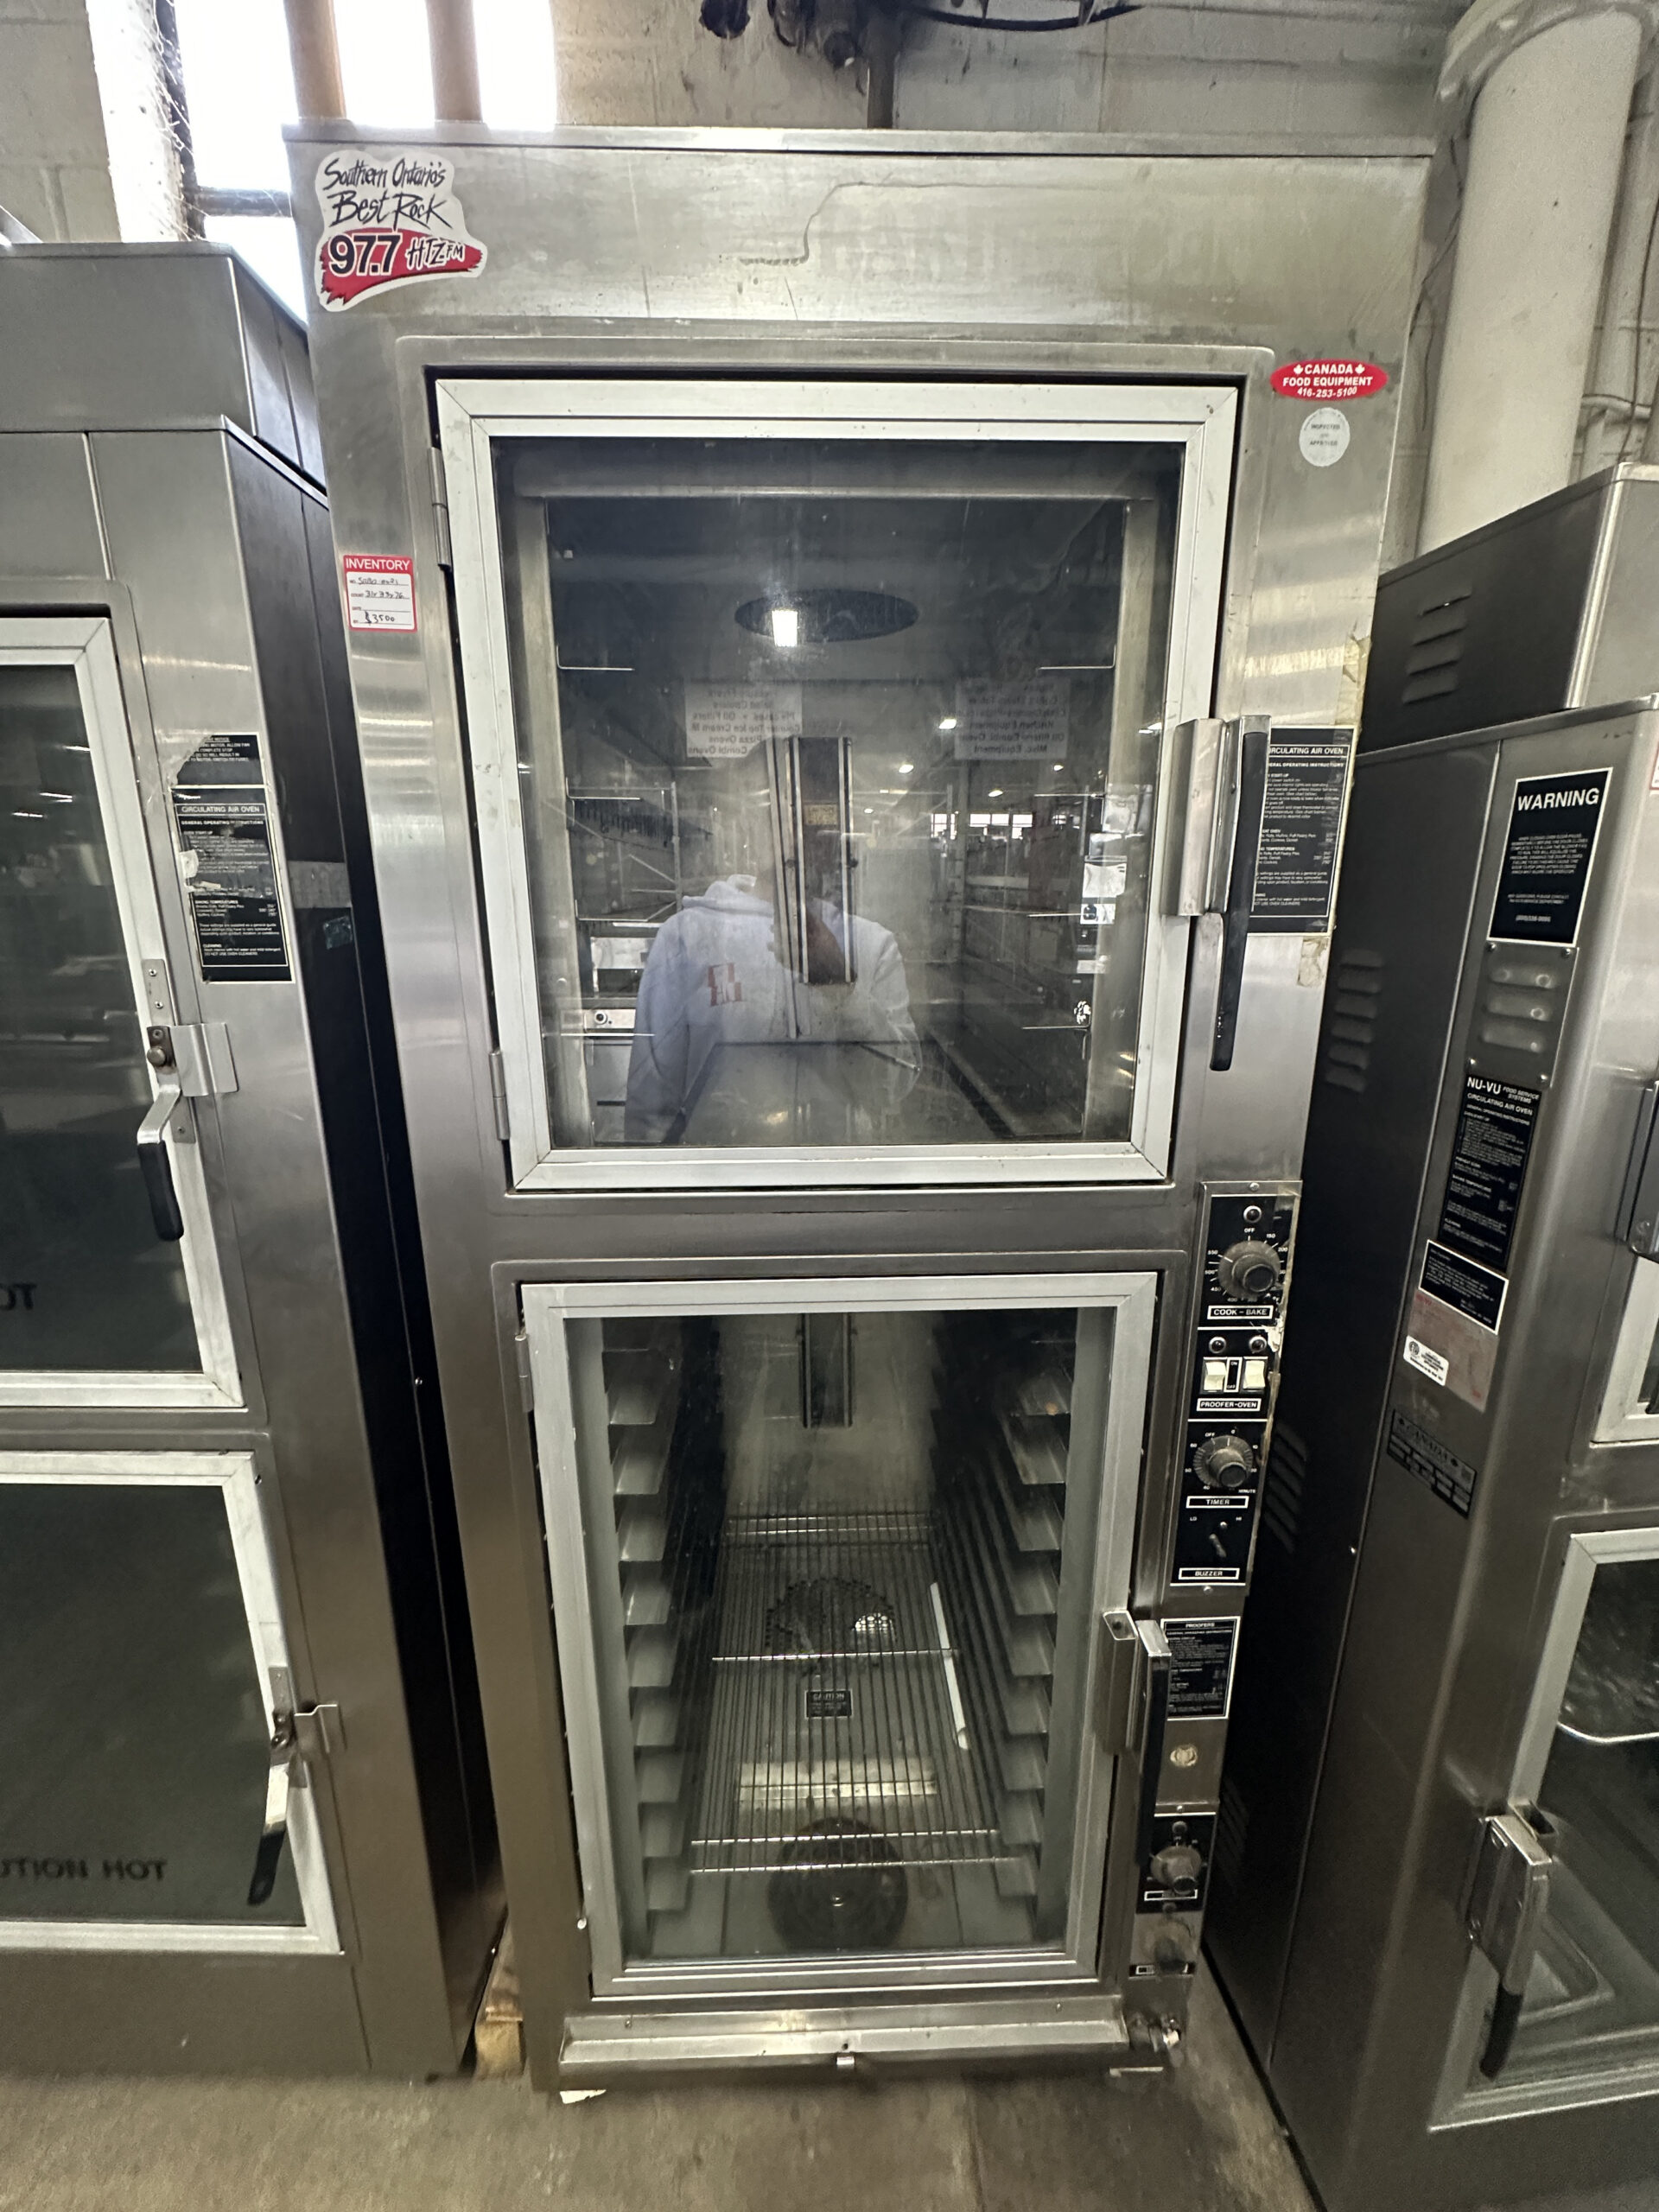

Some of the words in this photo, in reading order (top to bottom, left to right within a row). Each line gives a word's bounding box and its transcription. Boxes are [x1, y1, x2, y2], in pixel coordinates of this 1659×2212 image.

[322, 157, 387, 191] Southern
[391, 157, 446, 188] Ontario's
[327, 189, 390, 228] Best
[391, 192, 453, 232] Rock
[328, 233, 401, 275] 97.7
[1304, 364, 1353, 374] CANADA
[1282, 377, 1311, 386] FOOD
[1313, 377, 1373, 386] EQUIPMENT
[1297, 386, 1357, 397] 416-253-5100
[346, 558, 410, 570] INVENTORY
[1517, 787, 1599, 811] WARNING
[1466, 1077, 1502, 1095] NU-VU
[1503, 1086, 1517, 1095] FOOD
[1517, 1090, 1539, 1100] SERVICE
[1467, 1092, 1503, 1108] CIRCULATING
[1503, 1103, 1516, 1111] AIR
[1515, 1105, 1533, 1116] OVEN
[1508, 1093, 1532, 1103] SYSTEMS
[101, 1859, 168, 1881] HOT
